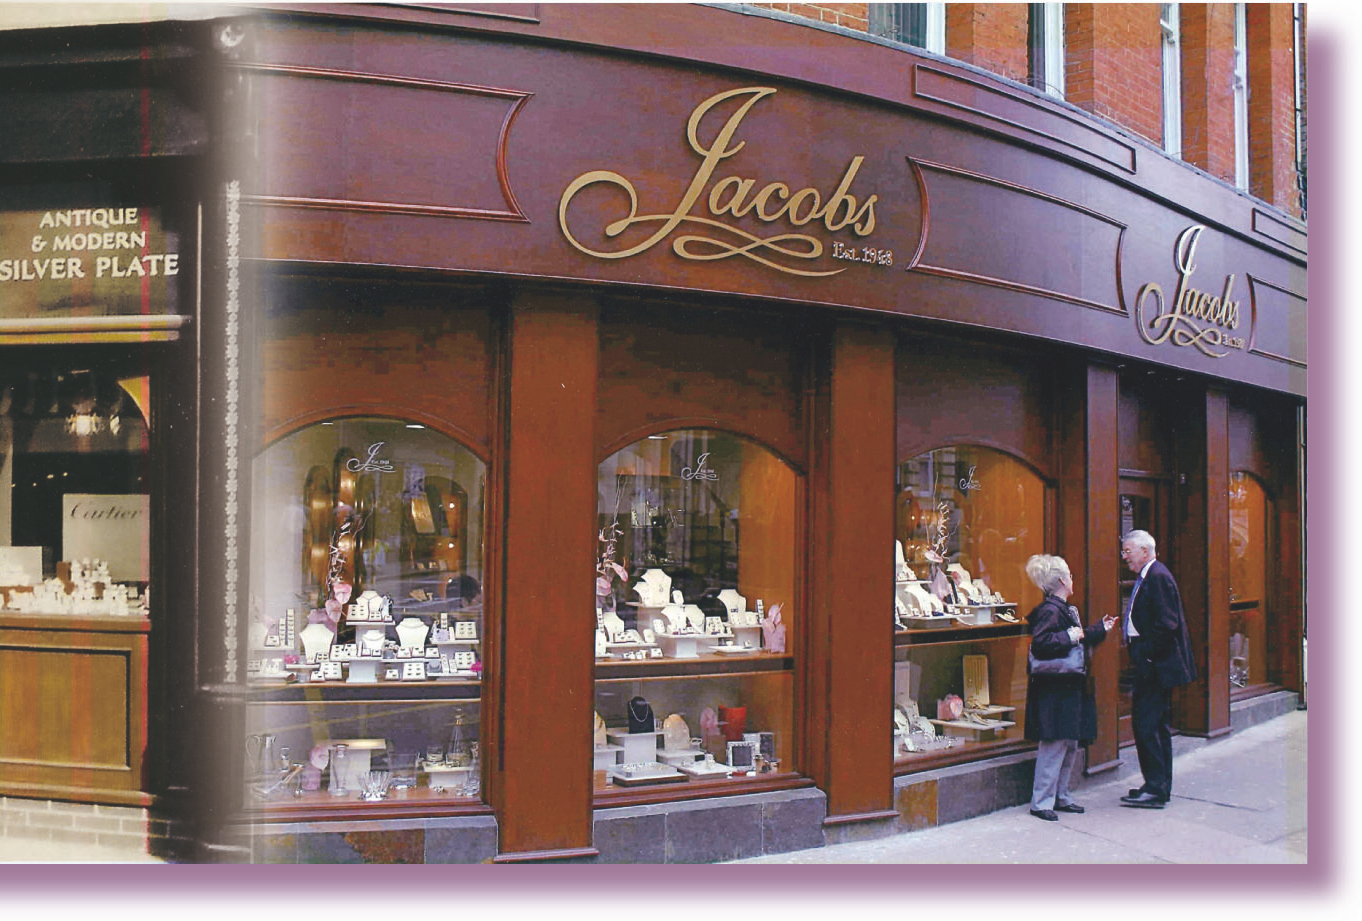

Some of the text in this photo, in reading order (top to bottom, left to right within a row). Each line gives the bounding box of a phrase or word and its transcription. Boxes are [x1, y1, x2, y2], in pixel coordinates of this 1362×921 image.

[558, 86, 878, 276] Jacobs
[39, 208, 138, 229] ANTIQUE
[31, 231, 146, 252] & MODERN
[96, 254, 179, 279] PLATE
[1139, 225, 1240, 357] Jacobs
